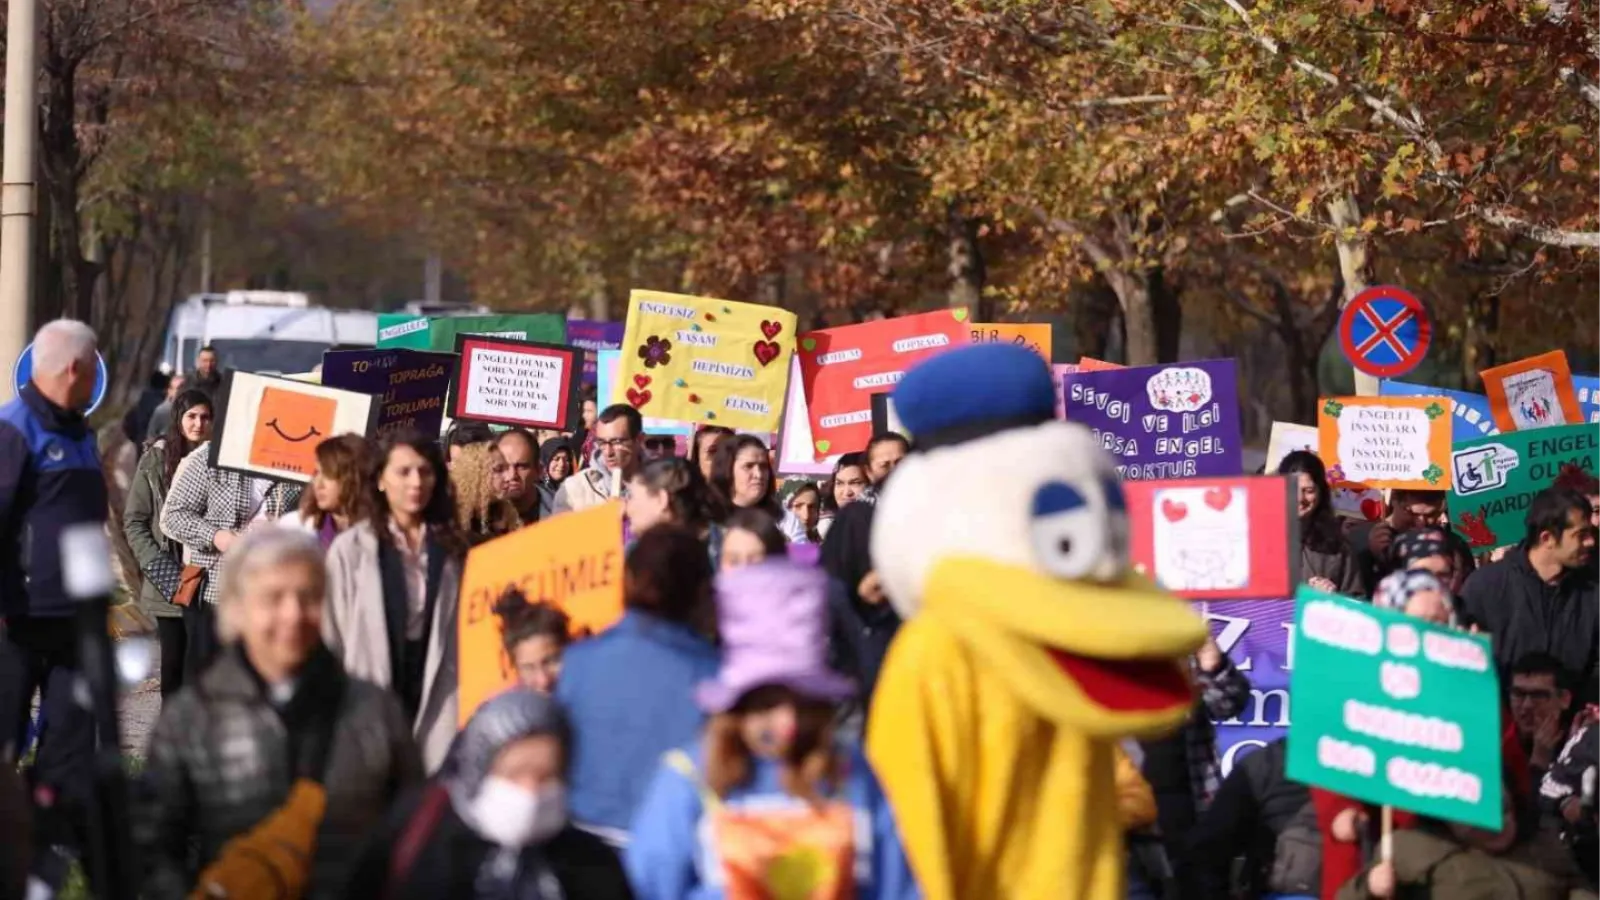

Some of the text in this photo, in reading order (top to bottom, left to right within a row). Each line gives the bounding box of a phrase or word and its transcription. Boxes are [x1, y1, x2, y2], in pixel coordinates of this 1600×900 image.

[676, 331, 717, 346] YAŞAM
[389, 363, 444, 385] TOPRAĞA
[1142, 413, 1169, 433] VE
[1156, 436, 1225, 458] ENGEL
[1527, 433, 1598, 459] ENGEL
